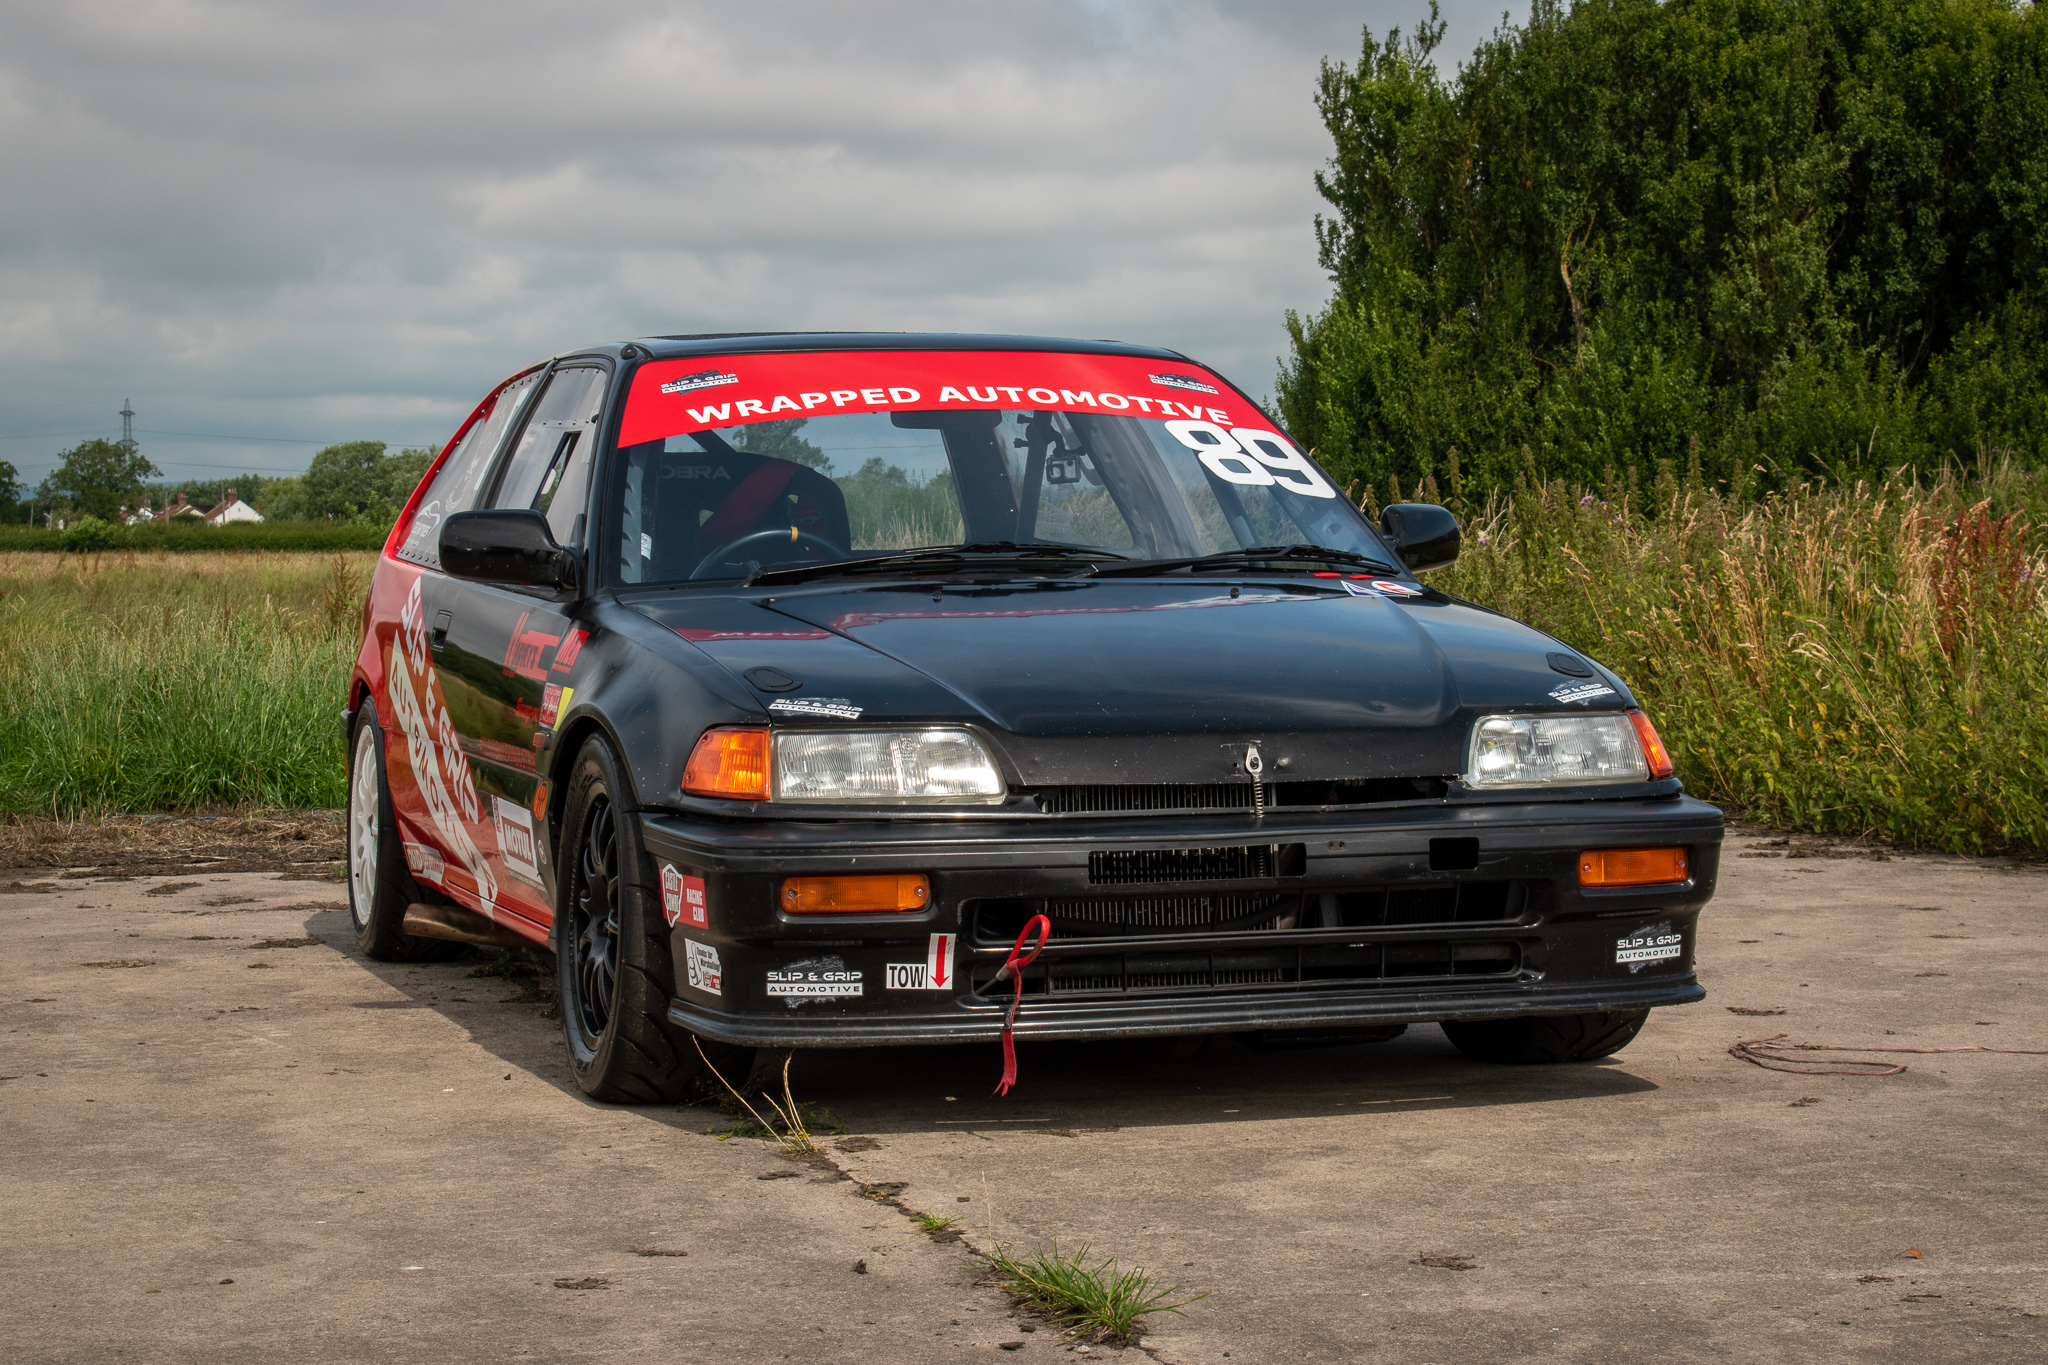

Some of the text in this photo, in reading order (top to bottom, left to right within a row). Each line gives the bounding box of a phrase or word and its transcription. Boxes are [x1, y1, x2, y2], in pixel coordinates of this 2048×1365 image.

[660, 379, 690, 389] SLIP
[705, 373, 736, 382] GRIP
[663, 378, 737, 393] AUTOMOTIVE
[685, 386, 1234, 426] WRAPPED AUTOMOTIVE
[1164, 420, 1336, 498] 89
[771, 704, 857, 716] AUTOMOTIVE
[826, 703, 864, 712] GRIP
[504, 823, 532, 861] MOTUL
[665, 871, 679, 892] CASTLE
[686, 888, 703, 906] RACING
[692, 906, 705, 923] CLUB
[1617, 934, 1682, 949] SLIP & GRIP
[1618, 947, 1679, 960] AUTOMOTIVE
[767, 972, 863, 981] SLIP & GRIP
[889, 965, 925, 988] TOW
[769, 985, 861, 993] AUTOMOTIVE
